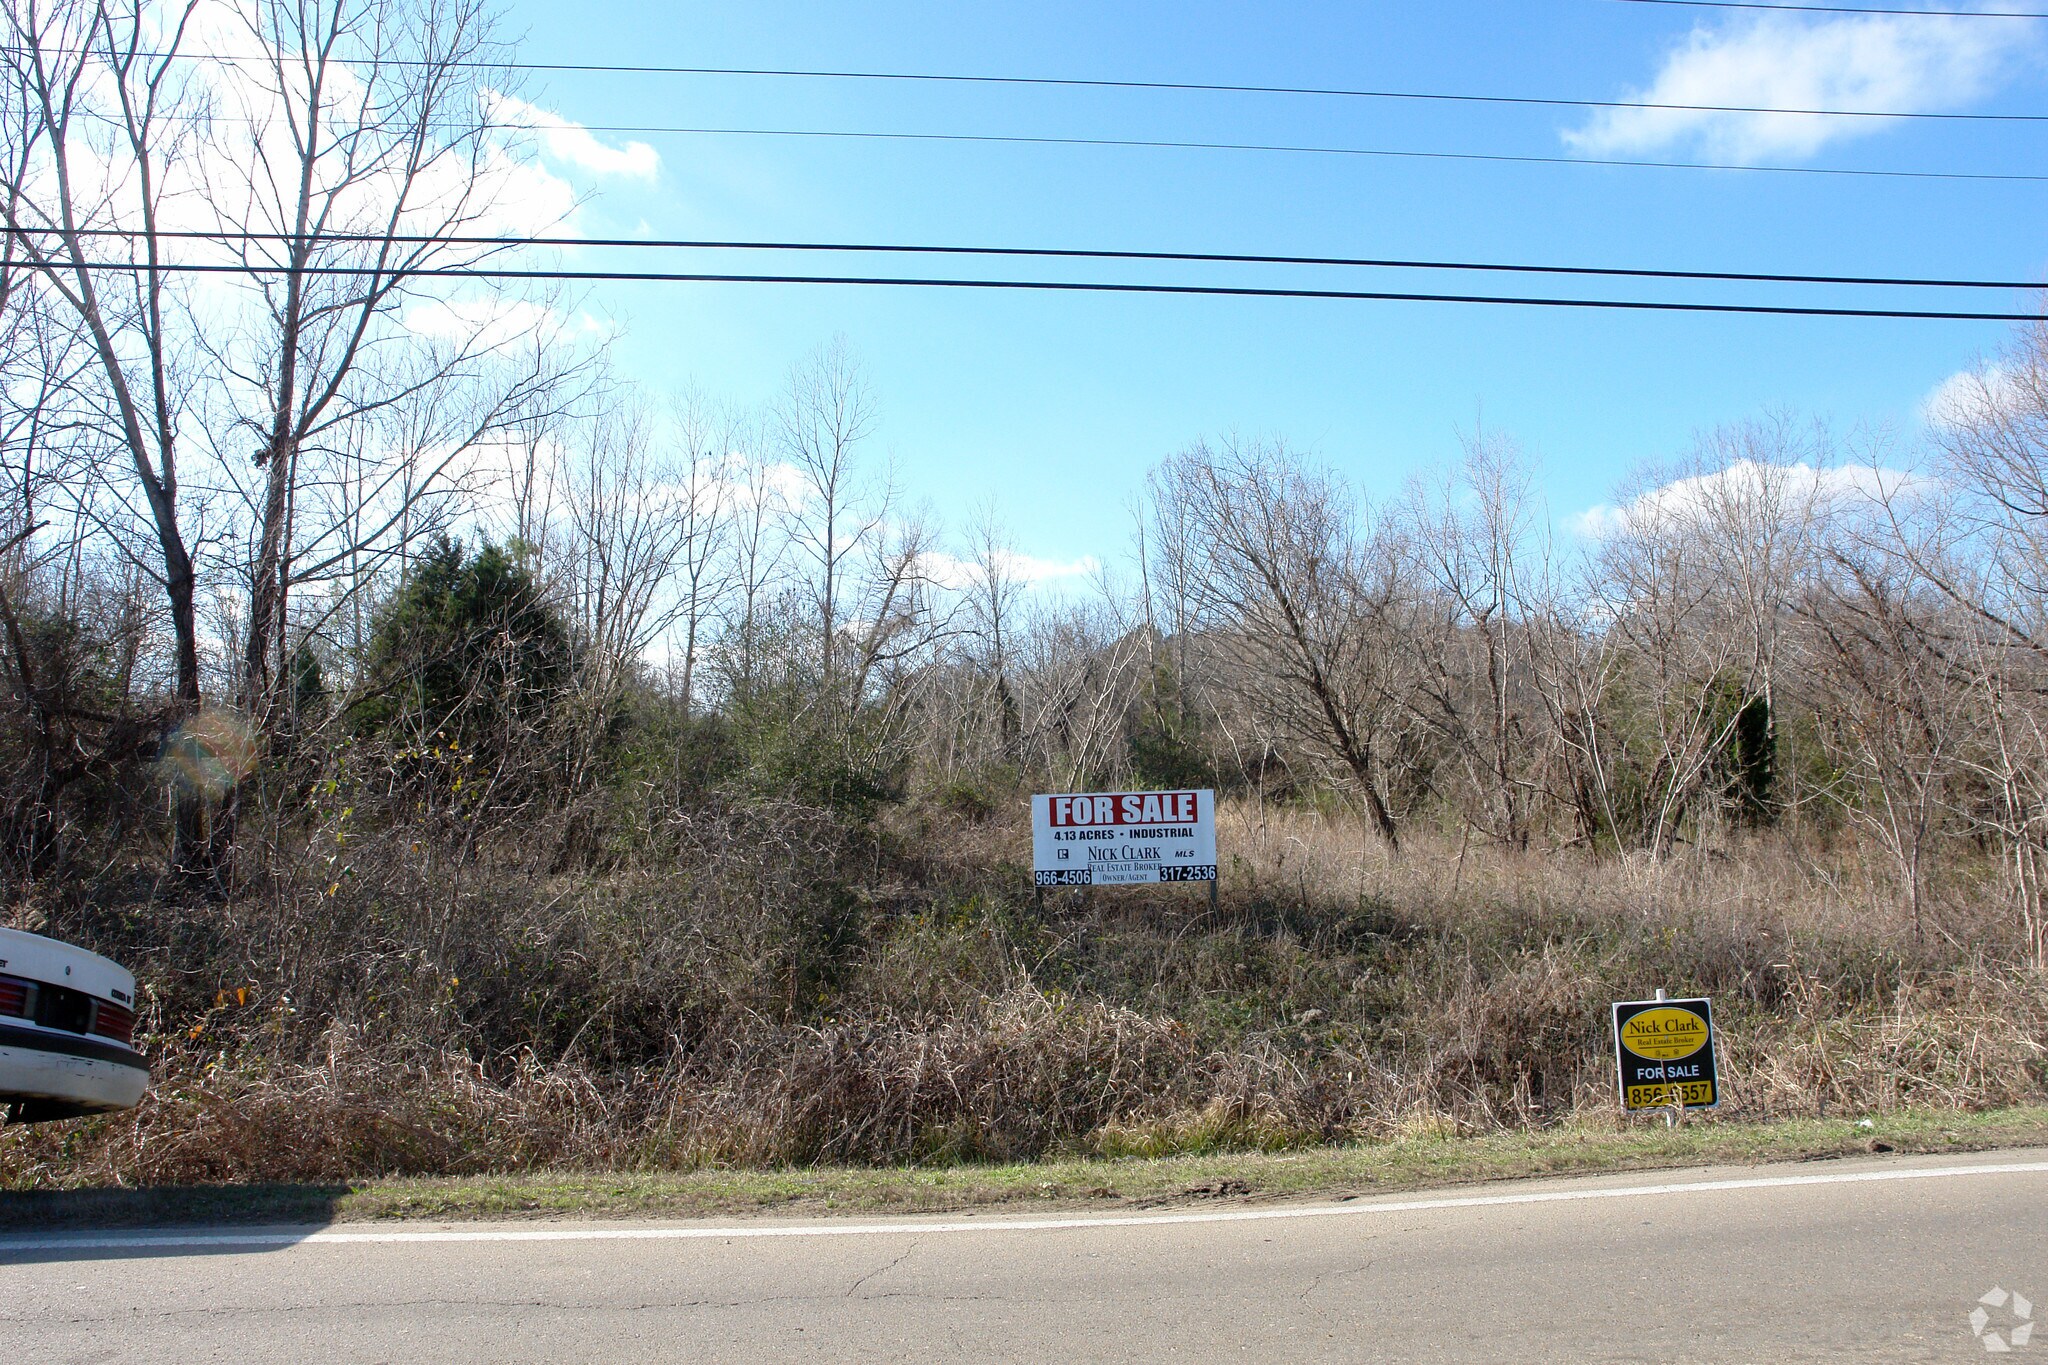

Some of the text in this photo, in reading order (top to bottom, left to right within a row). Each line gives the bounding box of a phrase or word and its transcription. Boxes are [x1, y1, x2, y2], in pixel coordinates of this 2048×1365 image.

[1056, 795, 1194, 825] FOR SALE
[1054, 828, 1194, 841] 4.13 ACRES INDUSTRIAL
[1088, 845, 1161, 860] NICK CLARK
[1175, 850, 1195, 858] MLS
[1107, 863, 1132, 872] ESTATE
[1161, 866, 1216, 880] 317-2536
[1035, 871, 1091, 885] 966-4506
[1630, 1018, 1699, 1034] Nick Clark
[1674, 1036, 1694, 1044] Broker
[1637, 1065, 1700, 1080] FOR SALE
